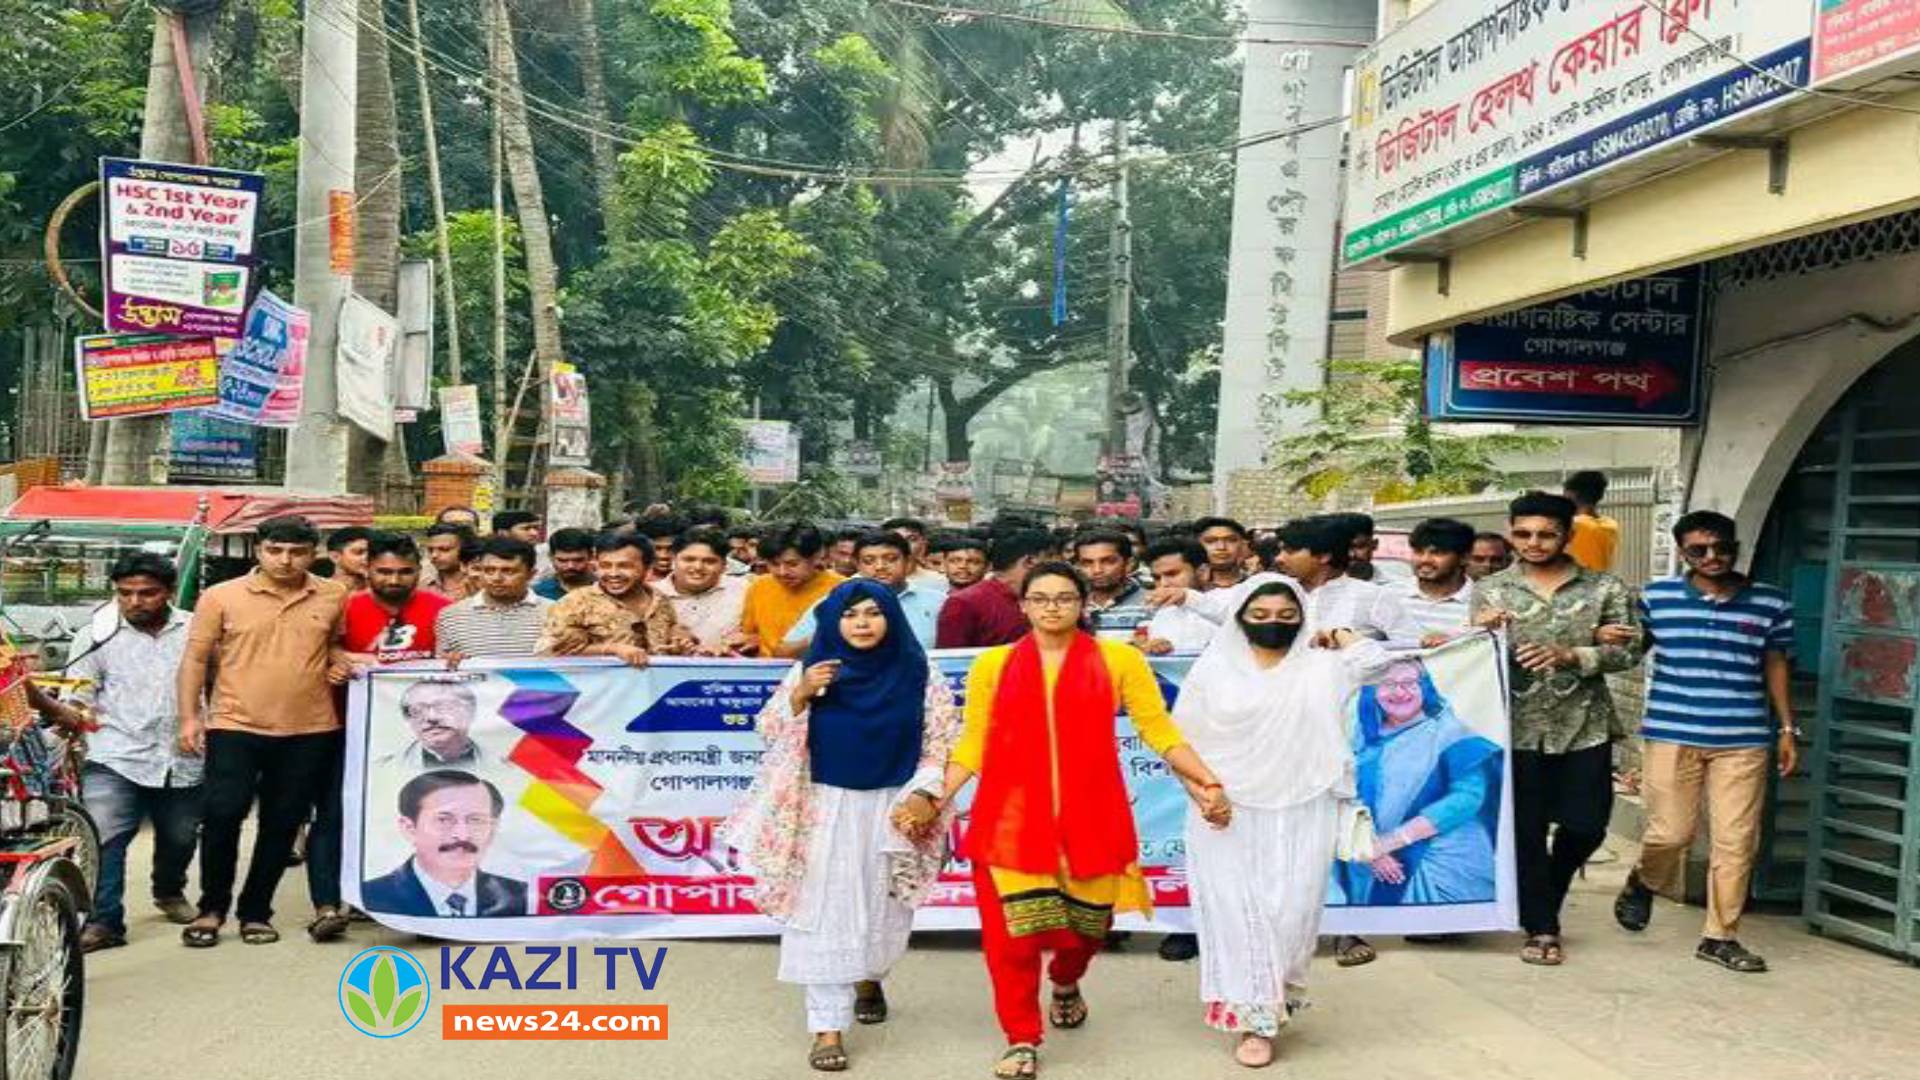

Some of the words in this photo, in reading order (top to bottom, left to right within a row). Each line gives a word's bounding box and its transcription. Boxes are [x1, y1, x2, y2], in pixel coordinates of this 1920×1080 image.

[1375, 103, 1461, 180] ডিজিটাল
[1549, 3, 1649, 95] কেয়ার
[117, 183, 160, 200] HSC
[163, 188, 194, 205] 1st
[199, 192, 249, 210] Year
[126, 203, 139, 216] &
[144, 202, 184, 220] 2nd
[189, 207, 239, 225] Year
[1610, 309, 1690, 335] সেন্টার
[1524, 336, 1628, 356] গোপালগঞ্জ
[1470, 366, 1579, 389] প্রবেশ
[1592, 371, 1655, 393] পথ
